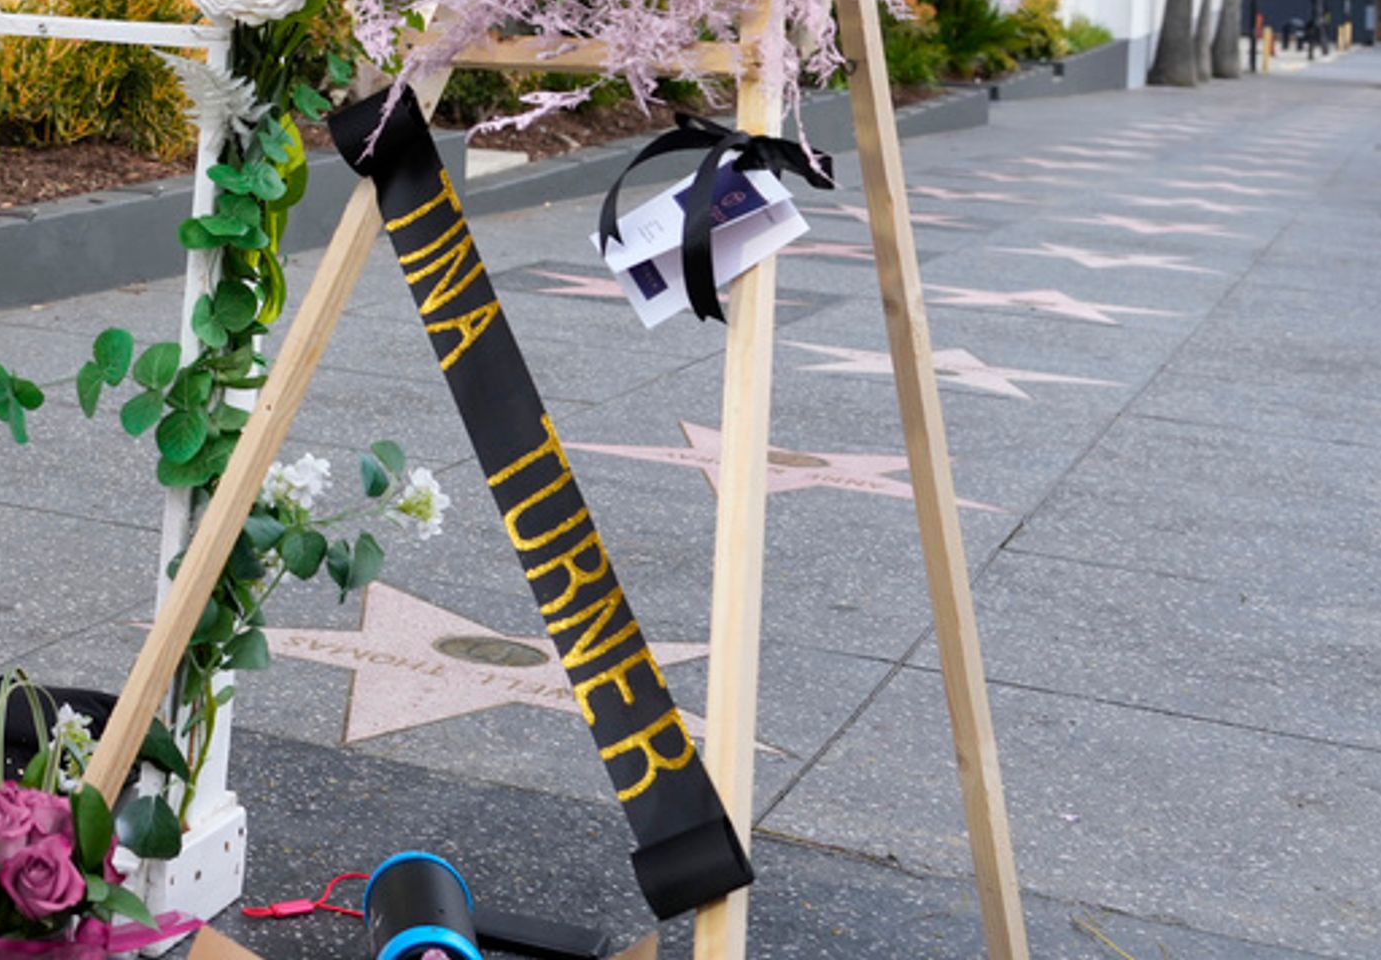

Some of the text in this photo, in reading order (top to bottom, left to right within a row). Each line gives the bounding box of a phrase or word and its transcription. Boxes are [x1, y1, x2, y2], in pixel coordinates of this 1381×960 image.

[385, 168, 695, 801] TINA TURNER
[283, 635, 444, 676] THOMAS
